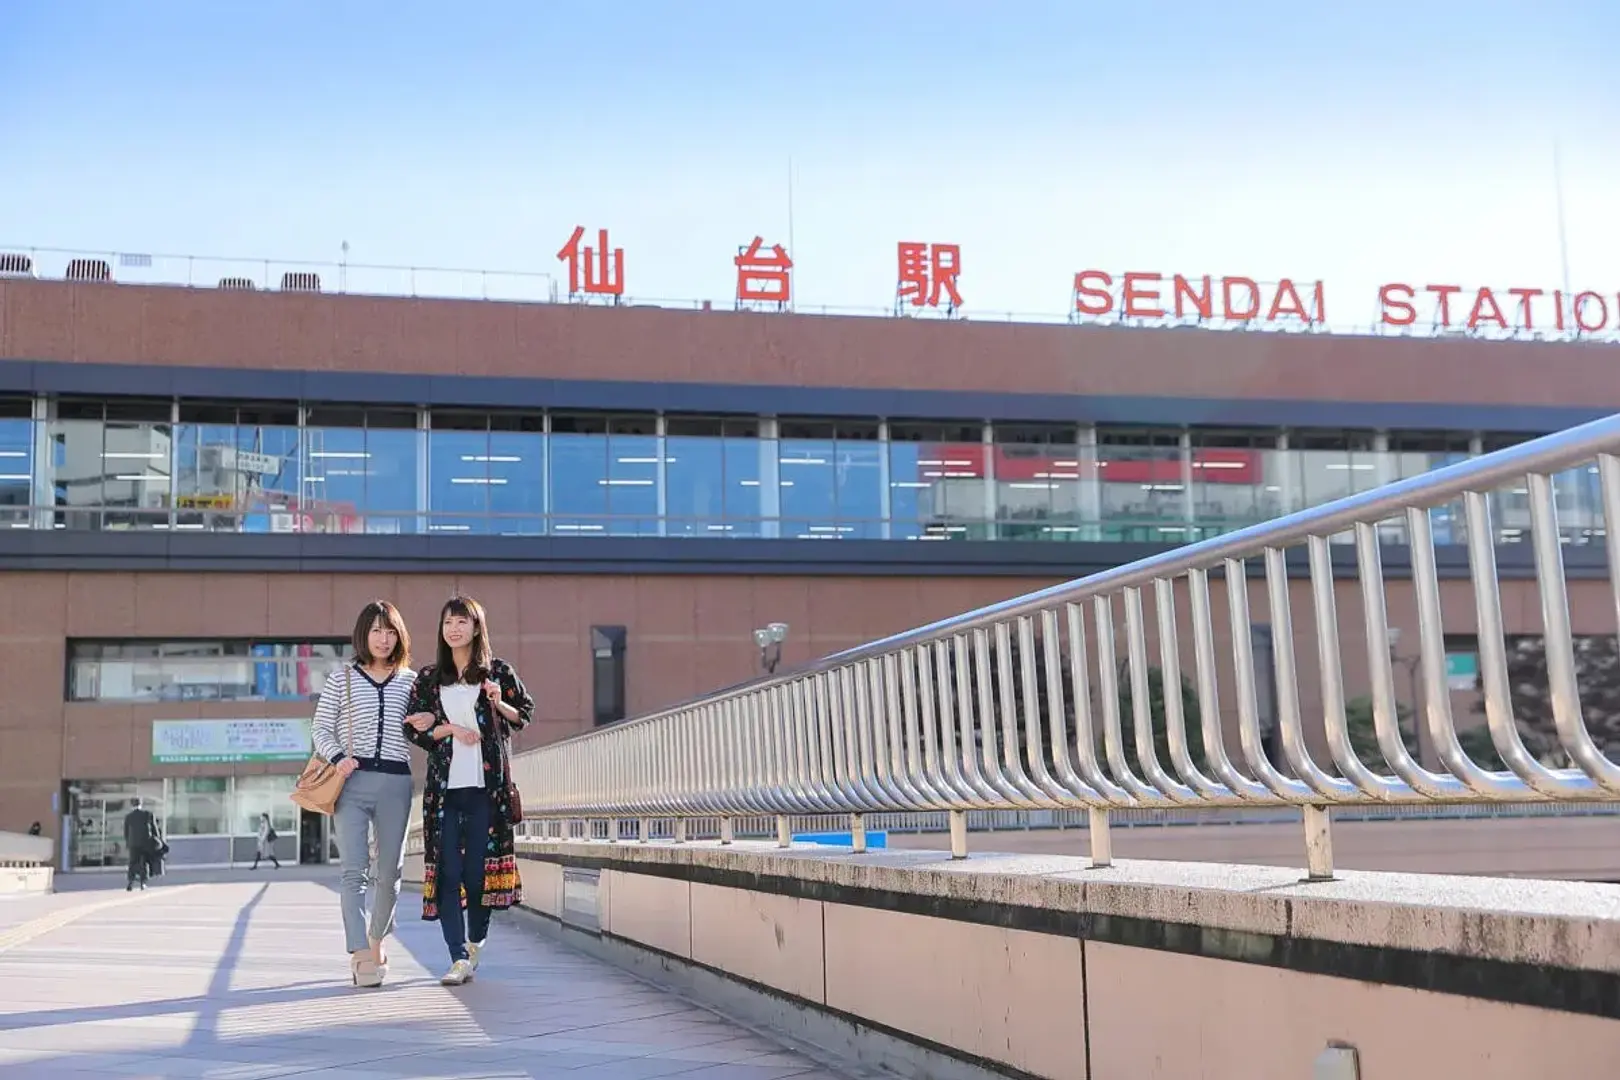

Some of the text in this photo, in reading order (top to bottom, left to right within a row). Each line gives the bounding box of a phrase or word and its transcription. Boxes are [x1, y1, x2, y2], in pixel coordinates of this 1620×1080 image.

[557, 226, 1620, 331] 仙台駅 SENDAI STATIO
